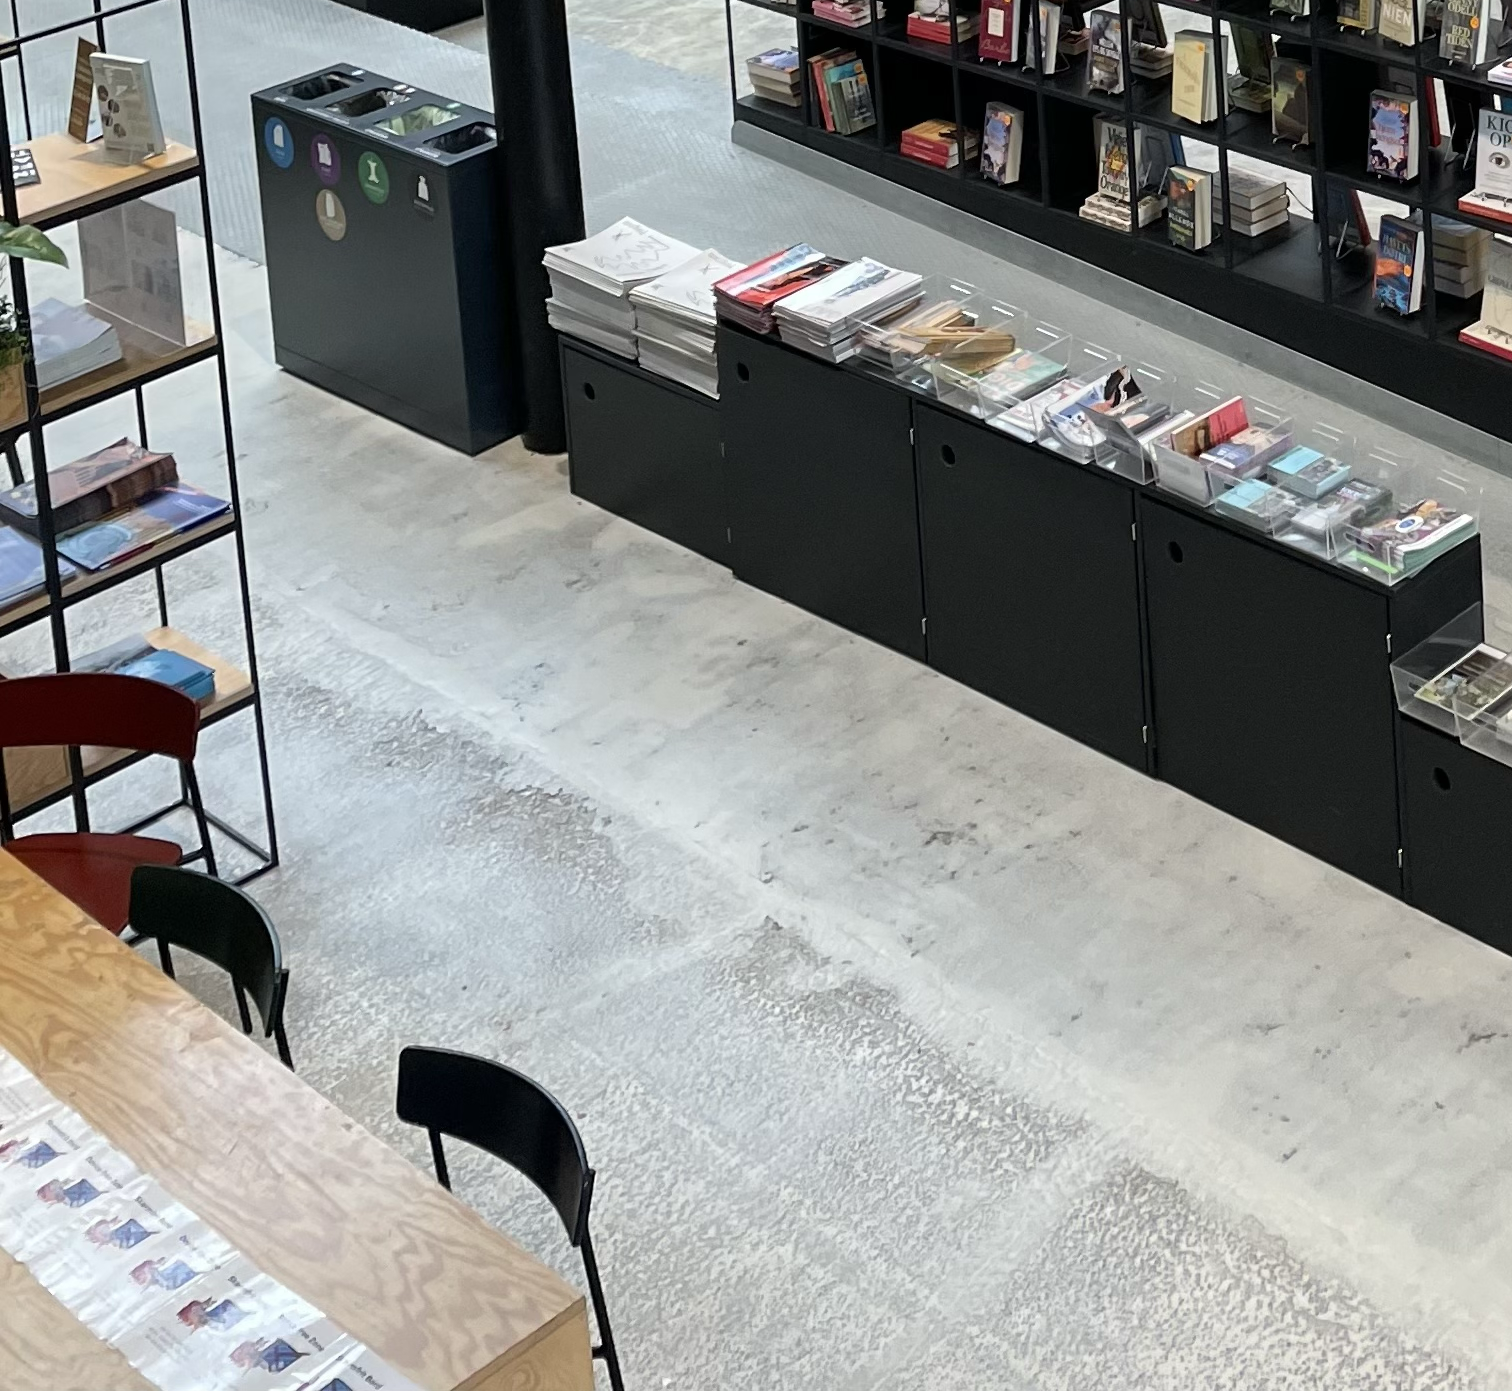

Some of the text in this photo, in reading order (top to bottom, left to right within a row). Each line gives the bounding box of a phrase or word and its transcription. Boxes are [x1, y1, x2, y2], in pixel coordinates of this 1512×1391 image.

[1381, 4, 1412, 28] NIEN
[1447, 2, 1478, 18] ODELL
[1452, 24, 1471, 38] RED
[1446, 32, 1473, 49] TIDEN
[1489, 131, 1512, 148] OP
